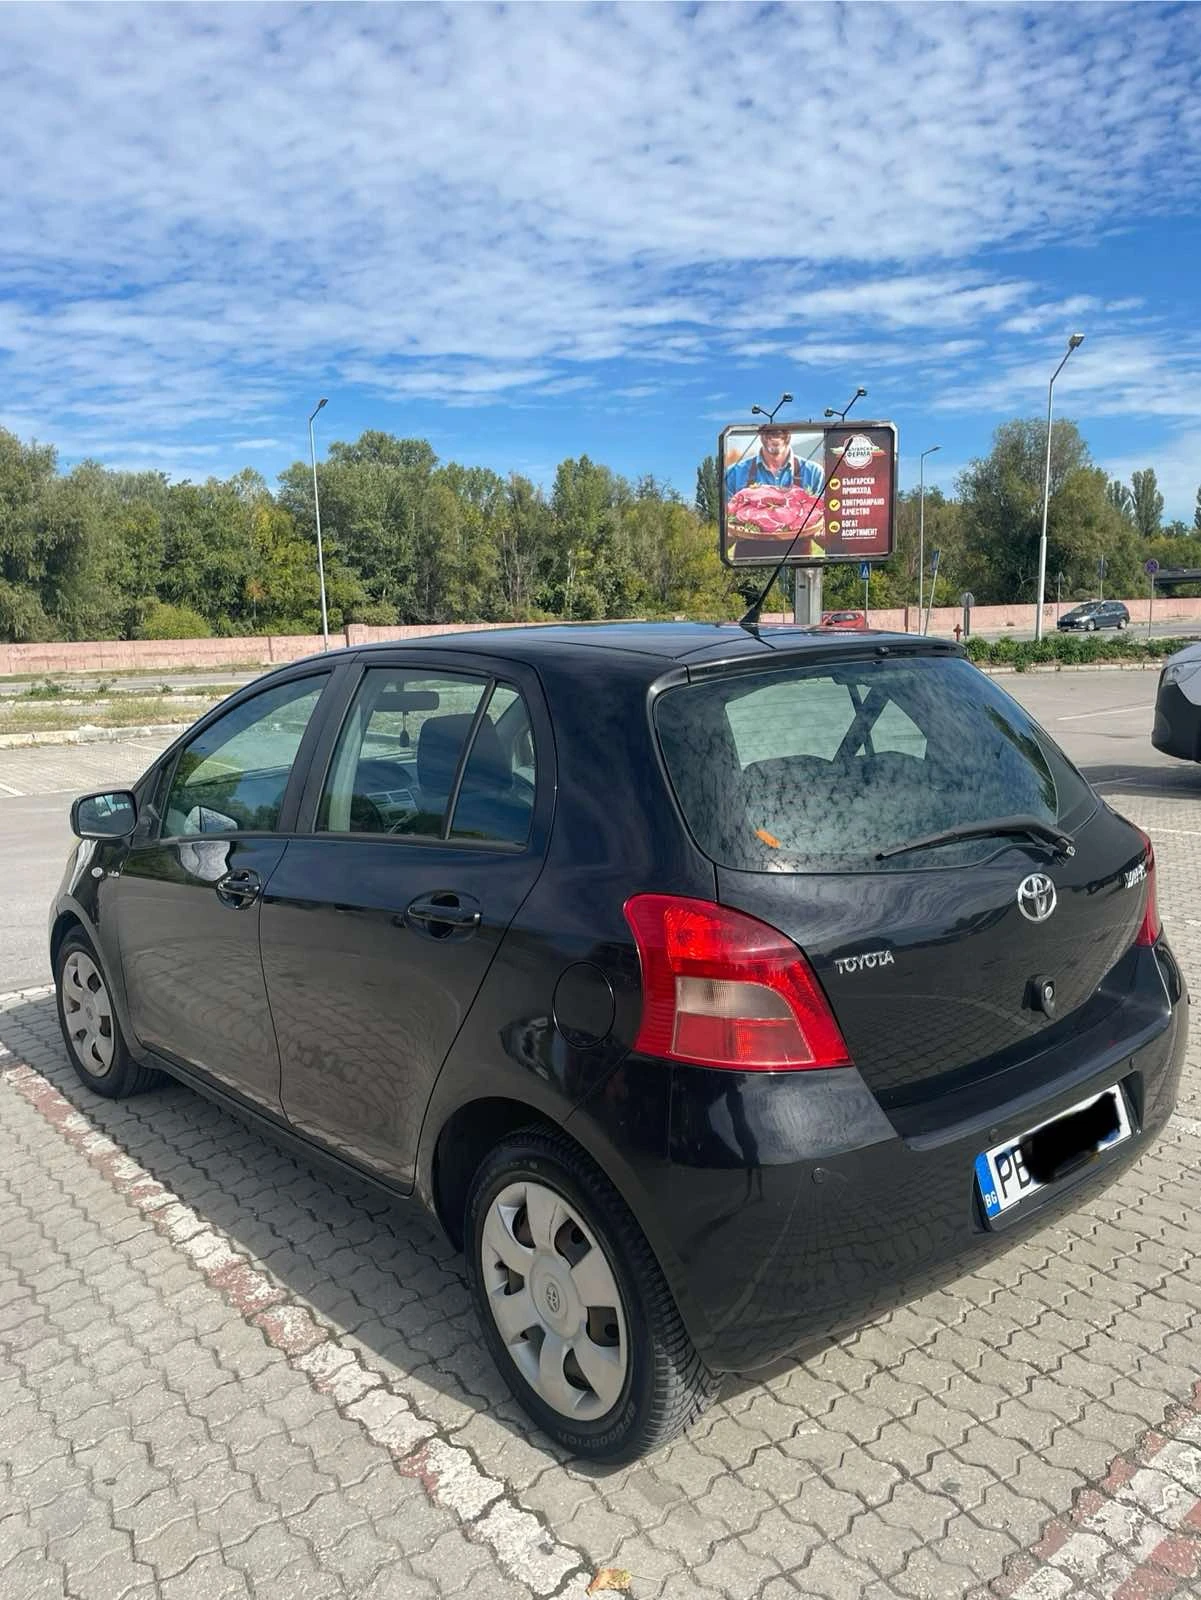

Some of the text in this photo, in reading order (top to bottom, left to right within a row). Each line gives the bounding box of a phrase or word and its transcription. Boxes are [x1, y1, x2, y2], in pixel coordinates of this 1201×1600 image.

[842, 477, 876, 486] БЪЛГАРСКИ
[842, 486, 872, 495] ПРОИЗХОД
[842, 498, 885, 506] КОНТРОЛИРАНО
[841, 507, 870, 516] КАЧЕСТВО
[841, 519, 858, 527] БОГАТ
[841, 528, 878, 537] АСОРТИМЕНТ
[834, 950, 895, 975] TOYOTA
[984, 1190, 998, 1209] BG
